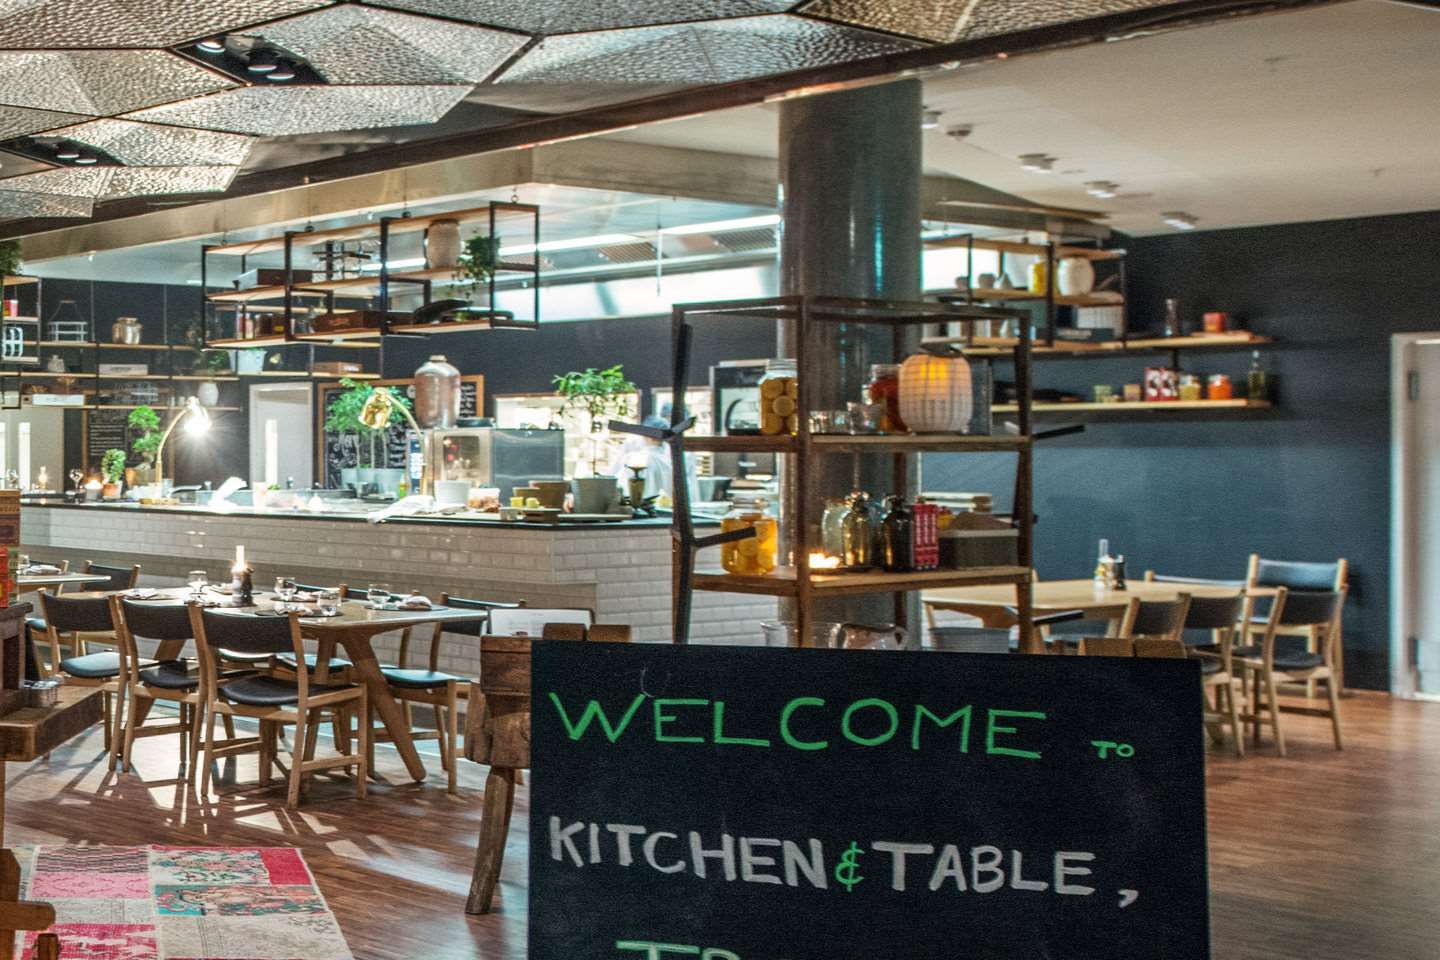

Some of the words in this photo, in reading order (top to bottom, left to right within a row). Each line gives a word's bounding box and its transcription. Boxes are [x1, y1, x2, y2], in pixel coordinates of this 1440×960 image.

[548, 691, 1047, 760] WELCOME
[1091, 740, 1135, 760] TO
[549, 815, 829, 890] KITCHEN
